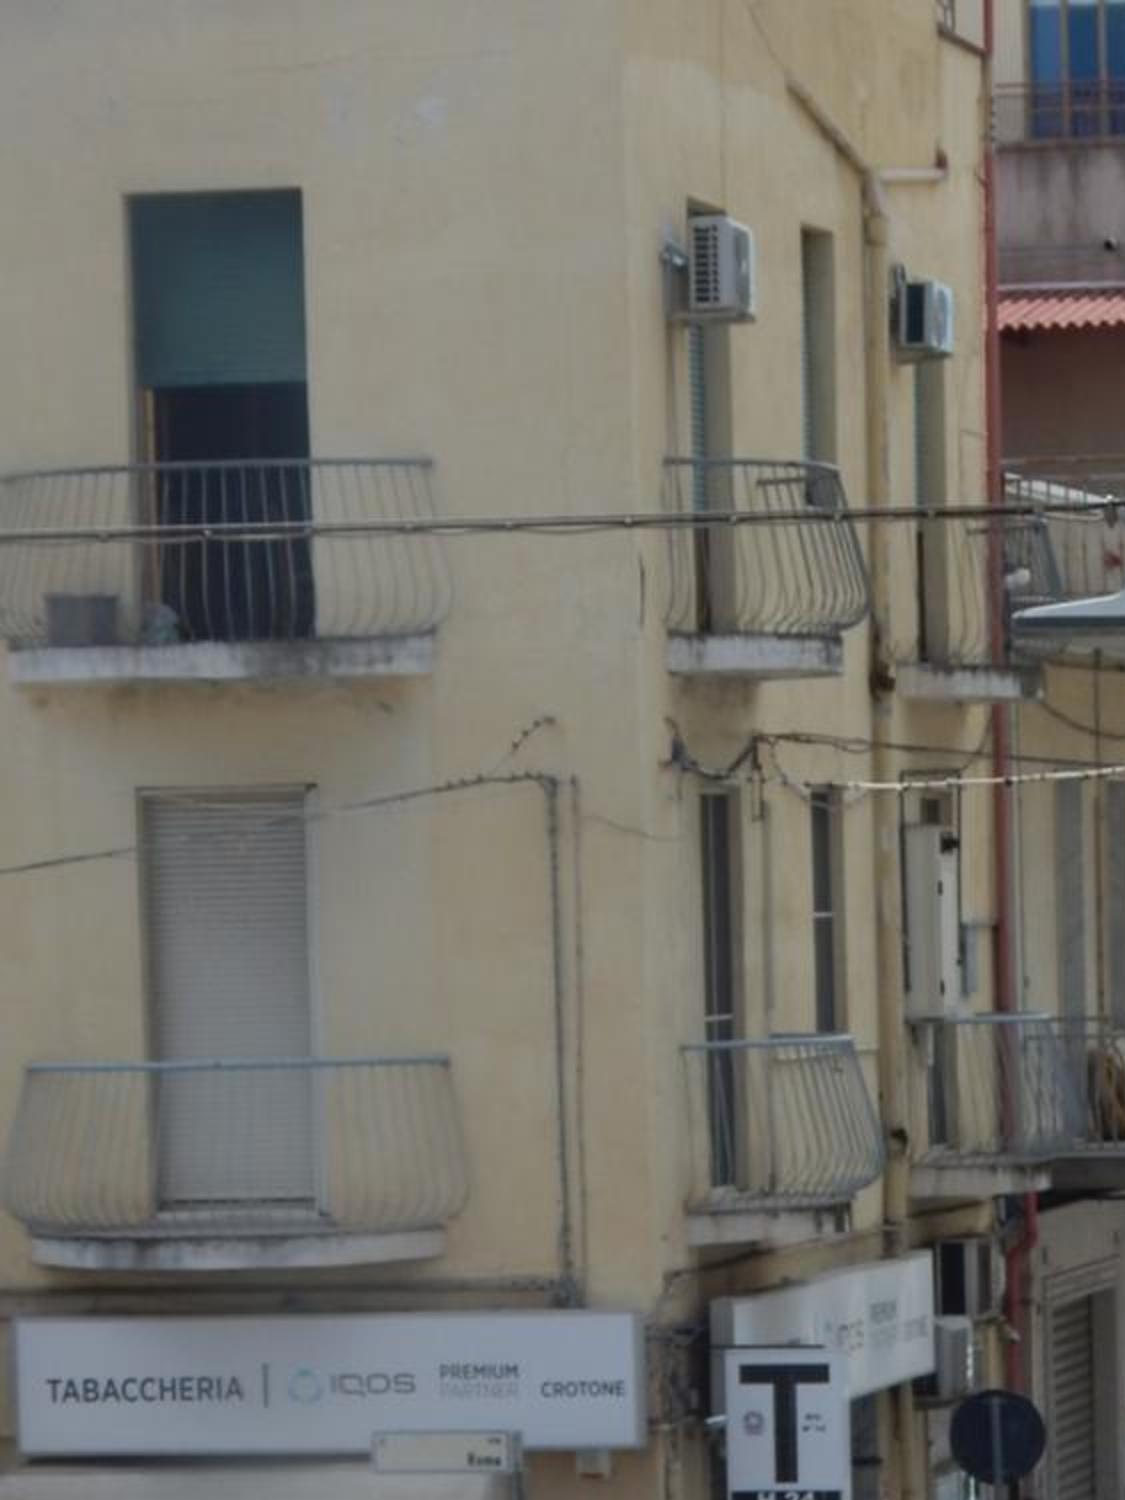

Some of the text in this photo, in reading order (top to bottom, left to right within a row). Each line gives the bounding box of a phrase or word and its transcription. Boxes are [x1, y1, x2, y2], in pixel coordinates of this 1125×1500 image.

[440, 1364, 519, 1379] PREMIUM
[46, 1375, 244, 1404] TABACCHERIA
[330, 1372, 416, 1397] IQOS
[540, 1380, 625, 1398] CROTONE
[739, 1364, 830, 1483] T
